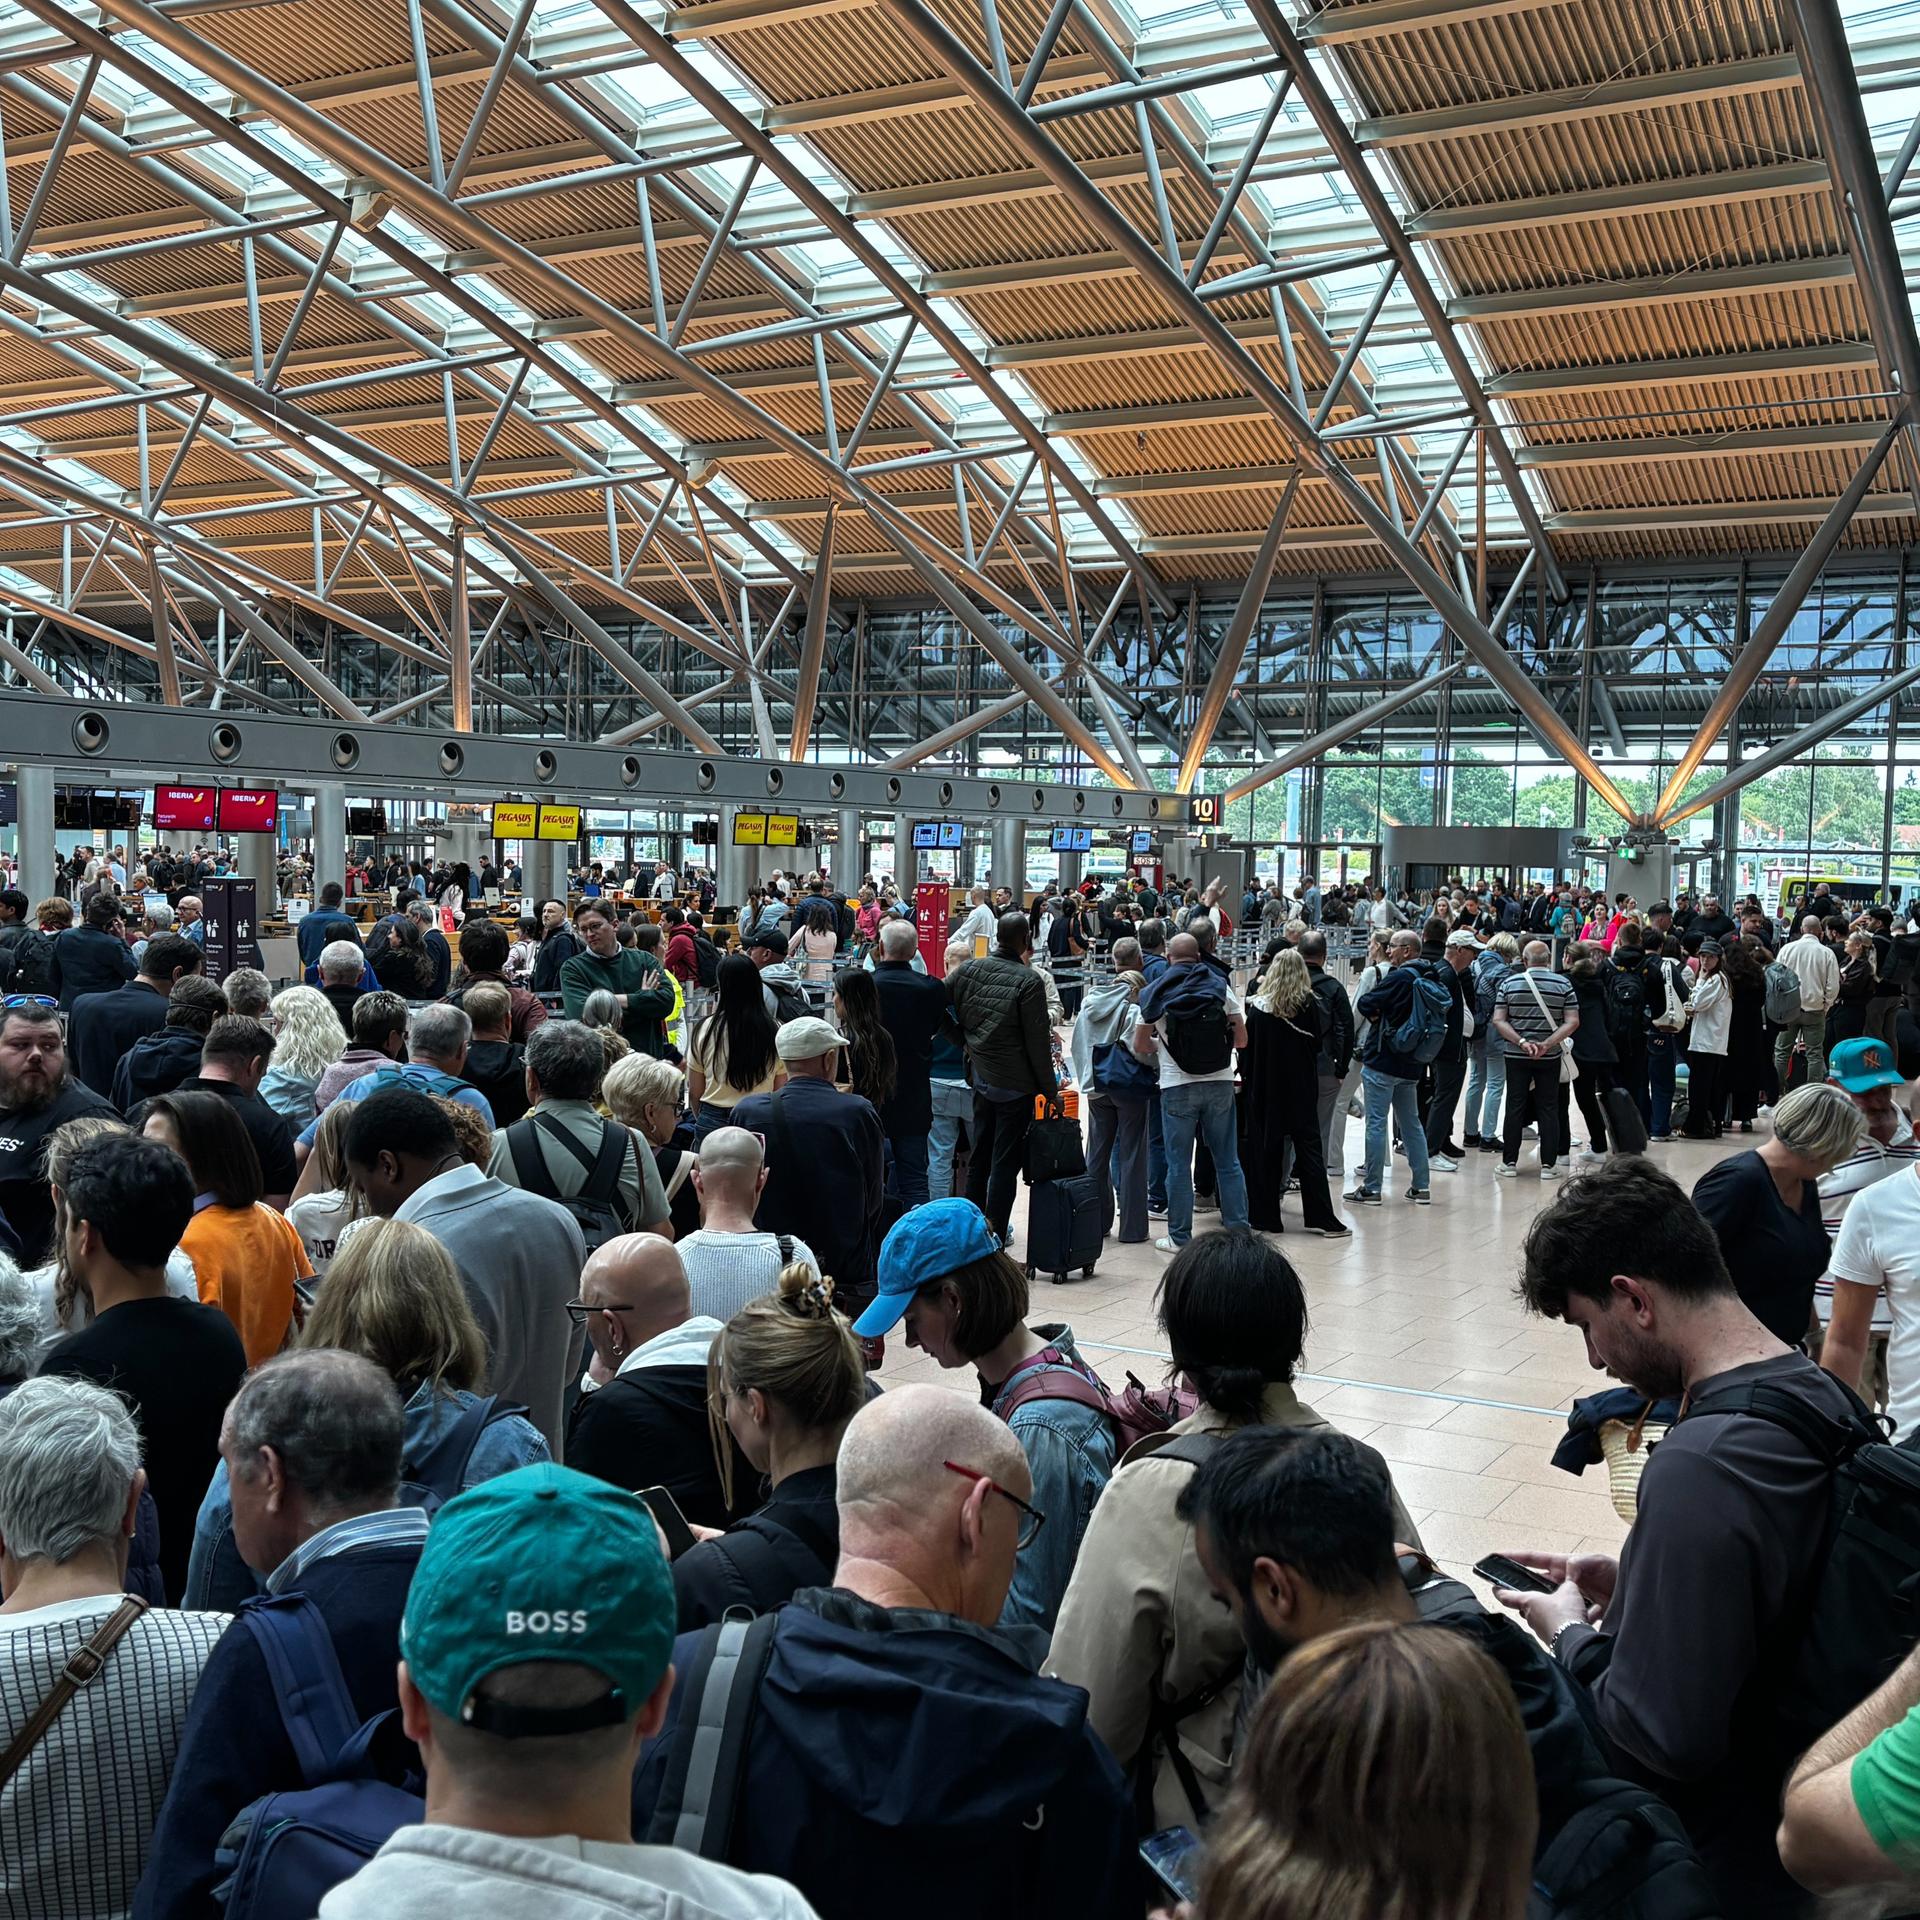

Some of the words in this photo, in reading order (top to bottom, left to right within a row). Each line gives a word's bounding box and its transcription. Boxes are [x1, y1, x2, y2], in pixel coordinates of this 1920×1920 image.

[168, 791, 194, 799] IBERIA
[231, 794, 257, 802] IBERIA
[1192, 798, 1213, 817] 10
[497, 813, 532, 823] PEGASUS
[542, 815, 575, 825] PEGASUS
[737, 822, 764, 831] PEGASUS
[769, 823, 795, 832] PEGASUS
[506, 1610, 588, 1635] BOSS
